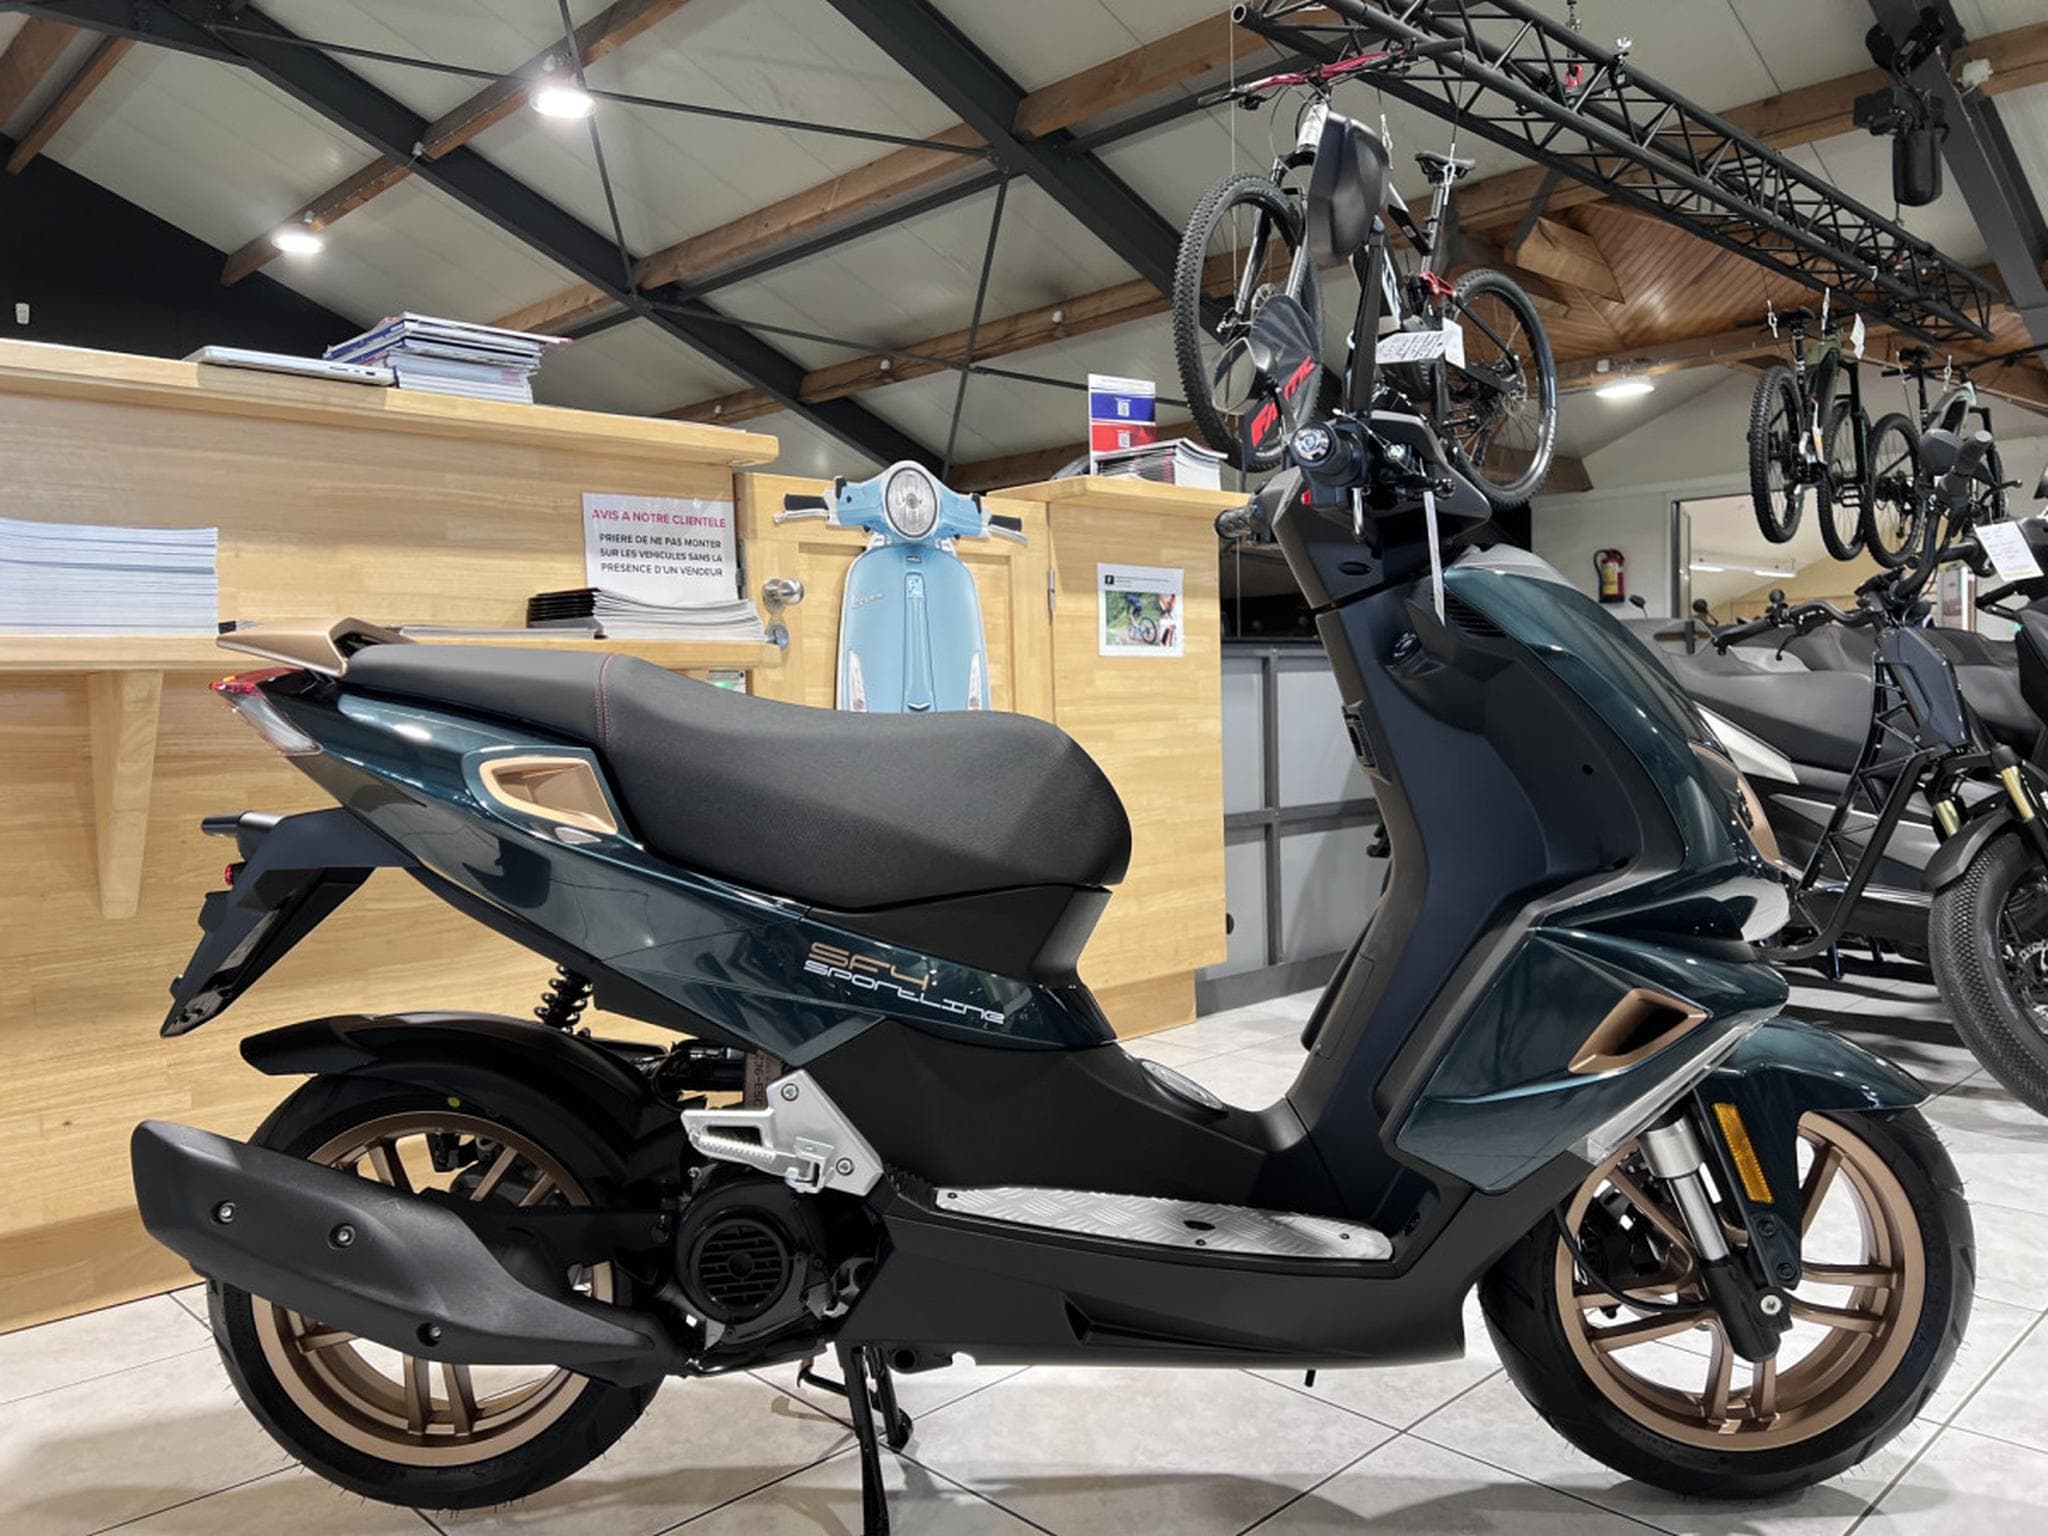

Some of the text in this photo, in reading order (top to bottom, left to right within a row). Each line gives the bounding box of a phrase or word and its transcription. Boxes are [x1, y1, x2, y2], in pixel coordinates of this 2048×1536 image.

[591, 509, 726, 528] AVIS A NOTRE CLIENTELE
[600, 533, 721, 548] PRIERE DE NE PAS MONTER
[600, 549, 722, 562] SUR LES VEHICULES SANS LA
[601, 563, 722, 576] PRESENCE D'UN VENDEUR
[808, 942, 929, 991] SF4
